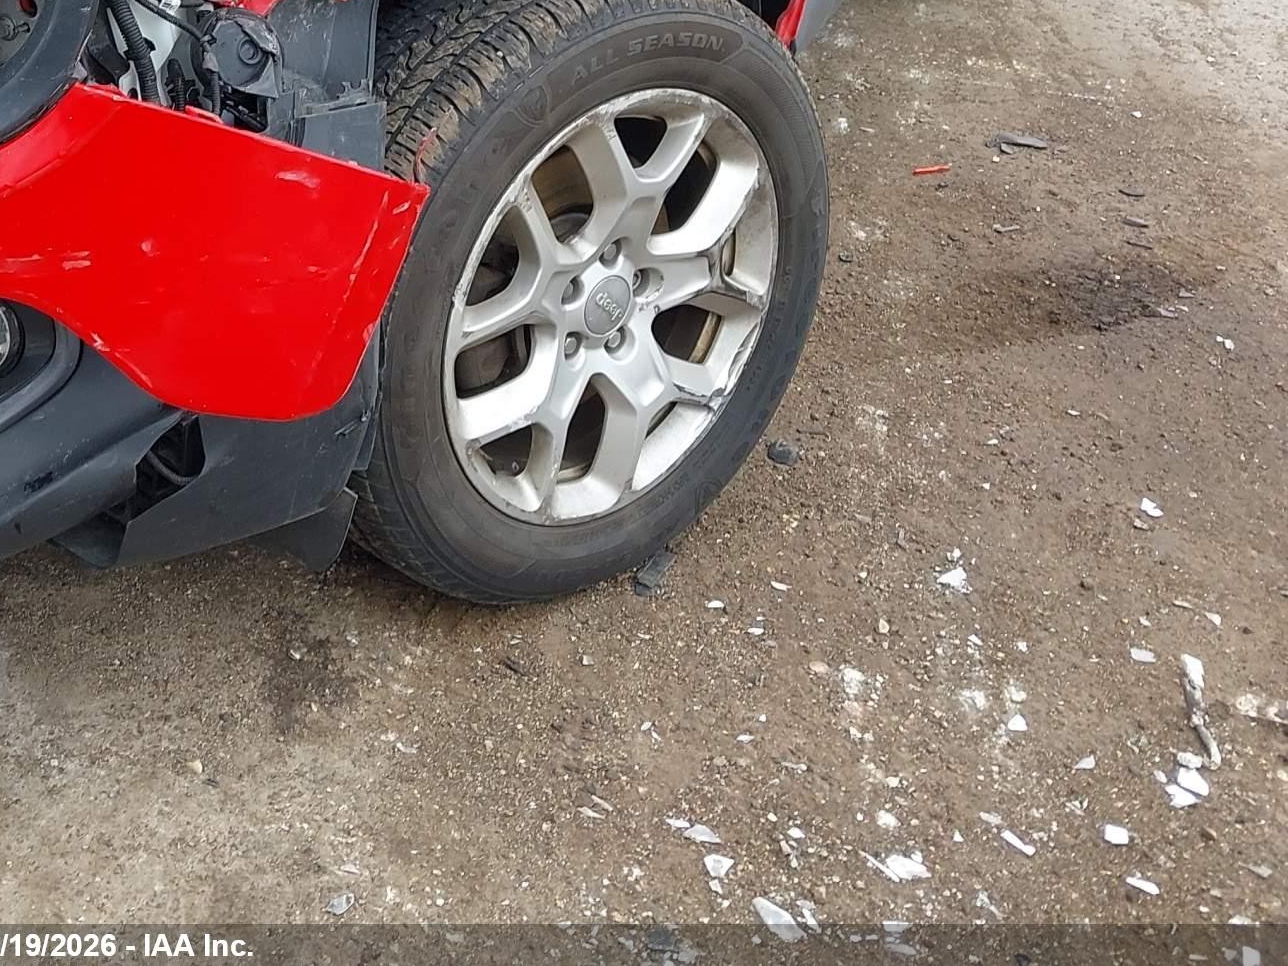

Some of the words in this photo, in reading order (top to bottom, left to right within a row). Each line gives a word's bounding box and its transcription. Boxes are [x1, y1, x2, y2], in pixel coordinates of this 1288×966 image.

[571, 49, 619, 86] ALL
[627, 32, 723, 56] SEASON
[595, 292, 623, 322] Jeep
